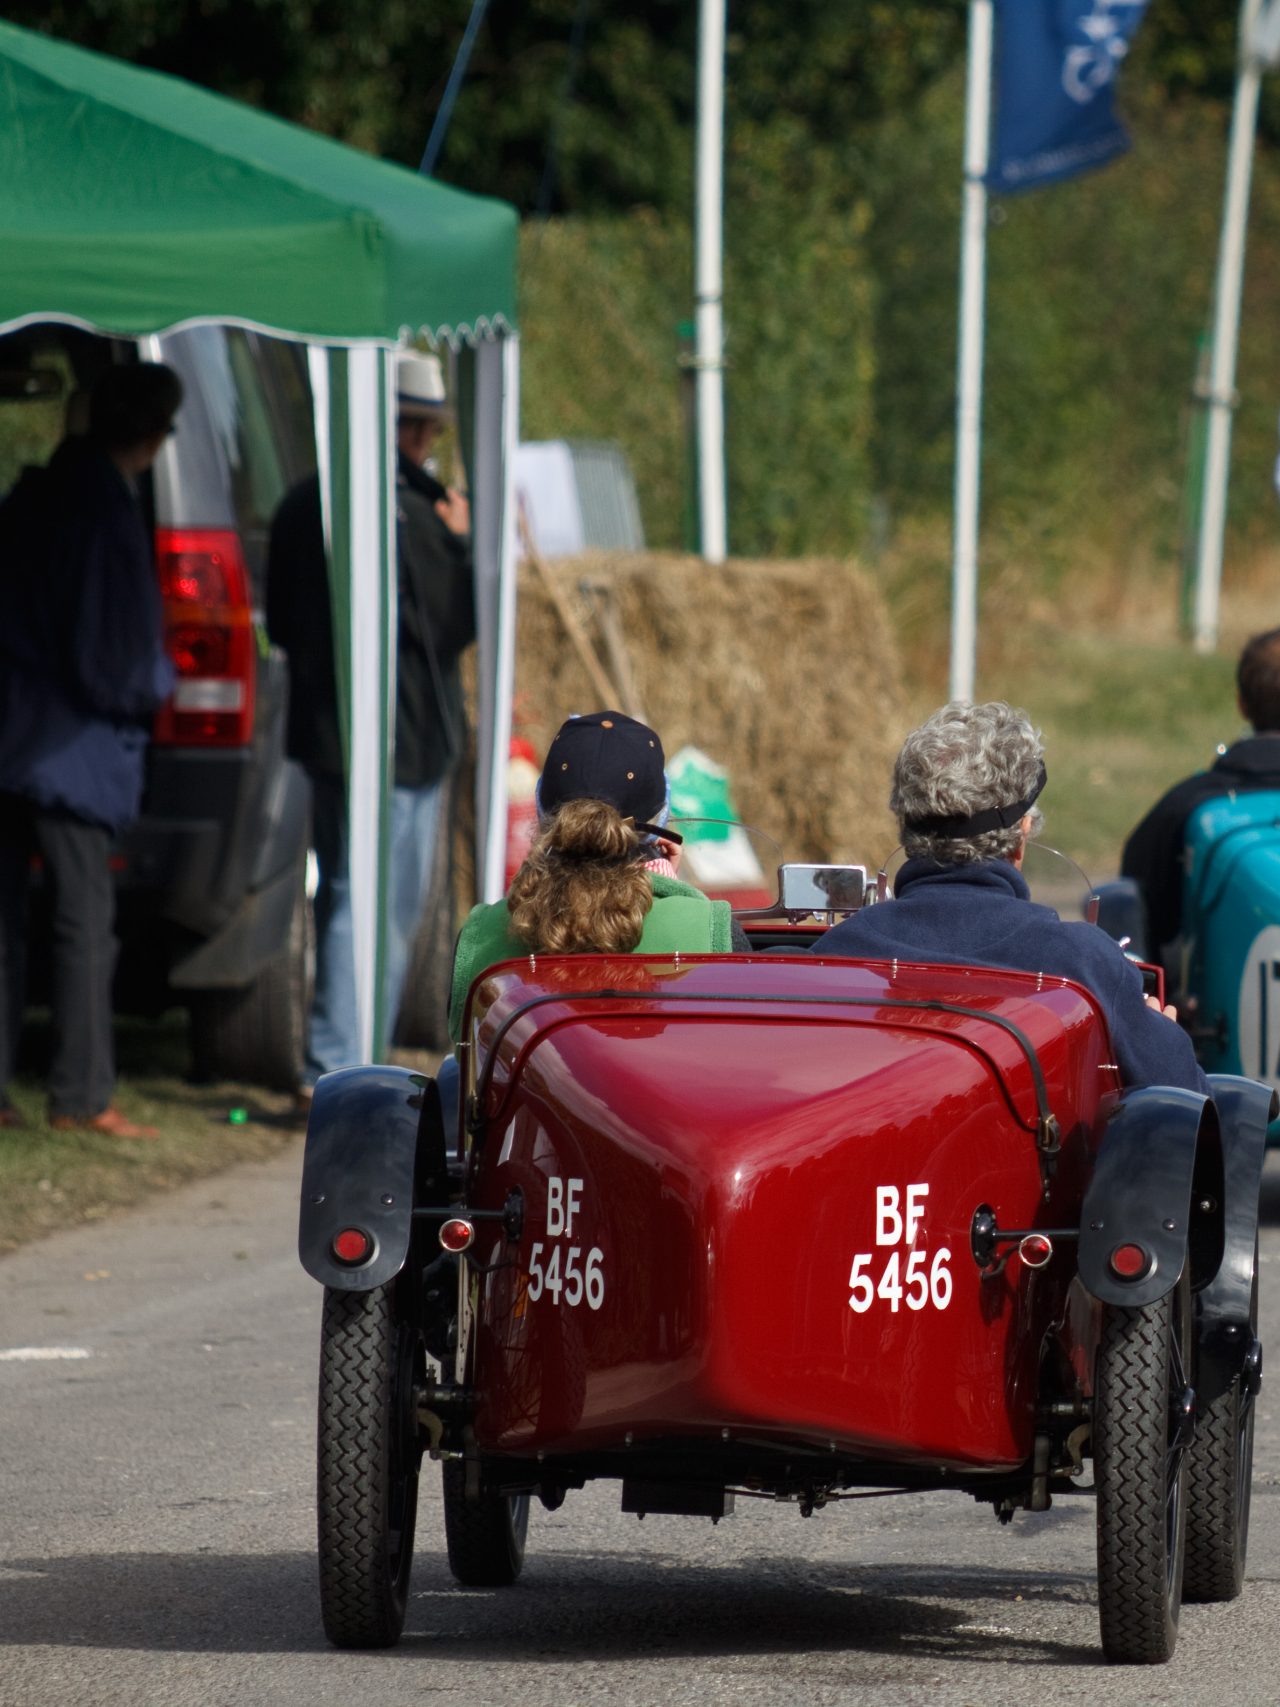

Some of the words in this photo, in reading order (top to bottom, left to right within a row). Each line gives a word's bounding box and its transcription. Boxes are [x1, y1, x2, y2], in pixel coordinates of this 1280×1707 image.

[546, 1176, 583, 1238] BF
[875, 1183, 930, 1246] BF
[528, 1242, 604, 1311] 5456
[848, 1248, 954, 1314] 5456
